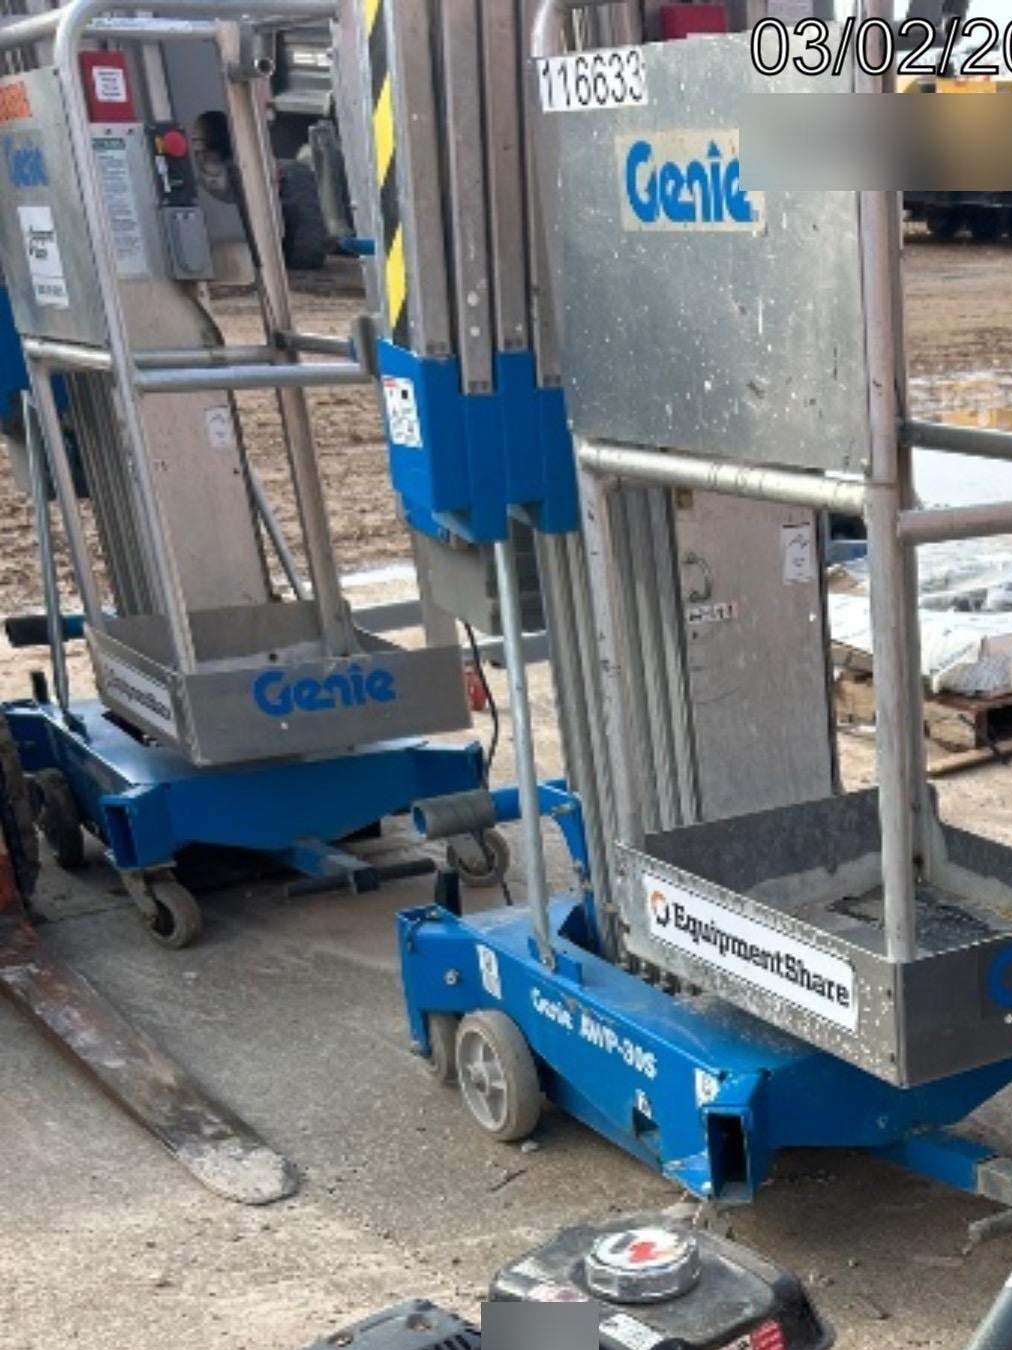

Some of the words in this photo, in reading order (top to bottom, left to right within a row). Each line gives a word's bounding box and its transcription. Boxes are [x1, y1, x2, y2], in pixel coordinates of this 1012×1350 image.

[542, 49, 643, 107] 116633
[625, 140, 758, 223] Genie
[252, 665, 397, 717] Genie
[672, 901, 849, 1008] EquipmentShare
